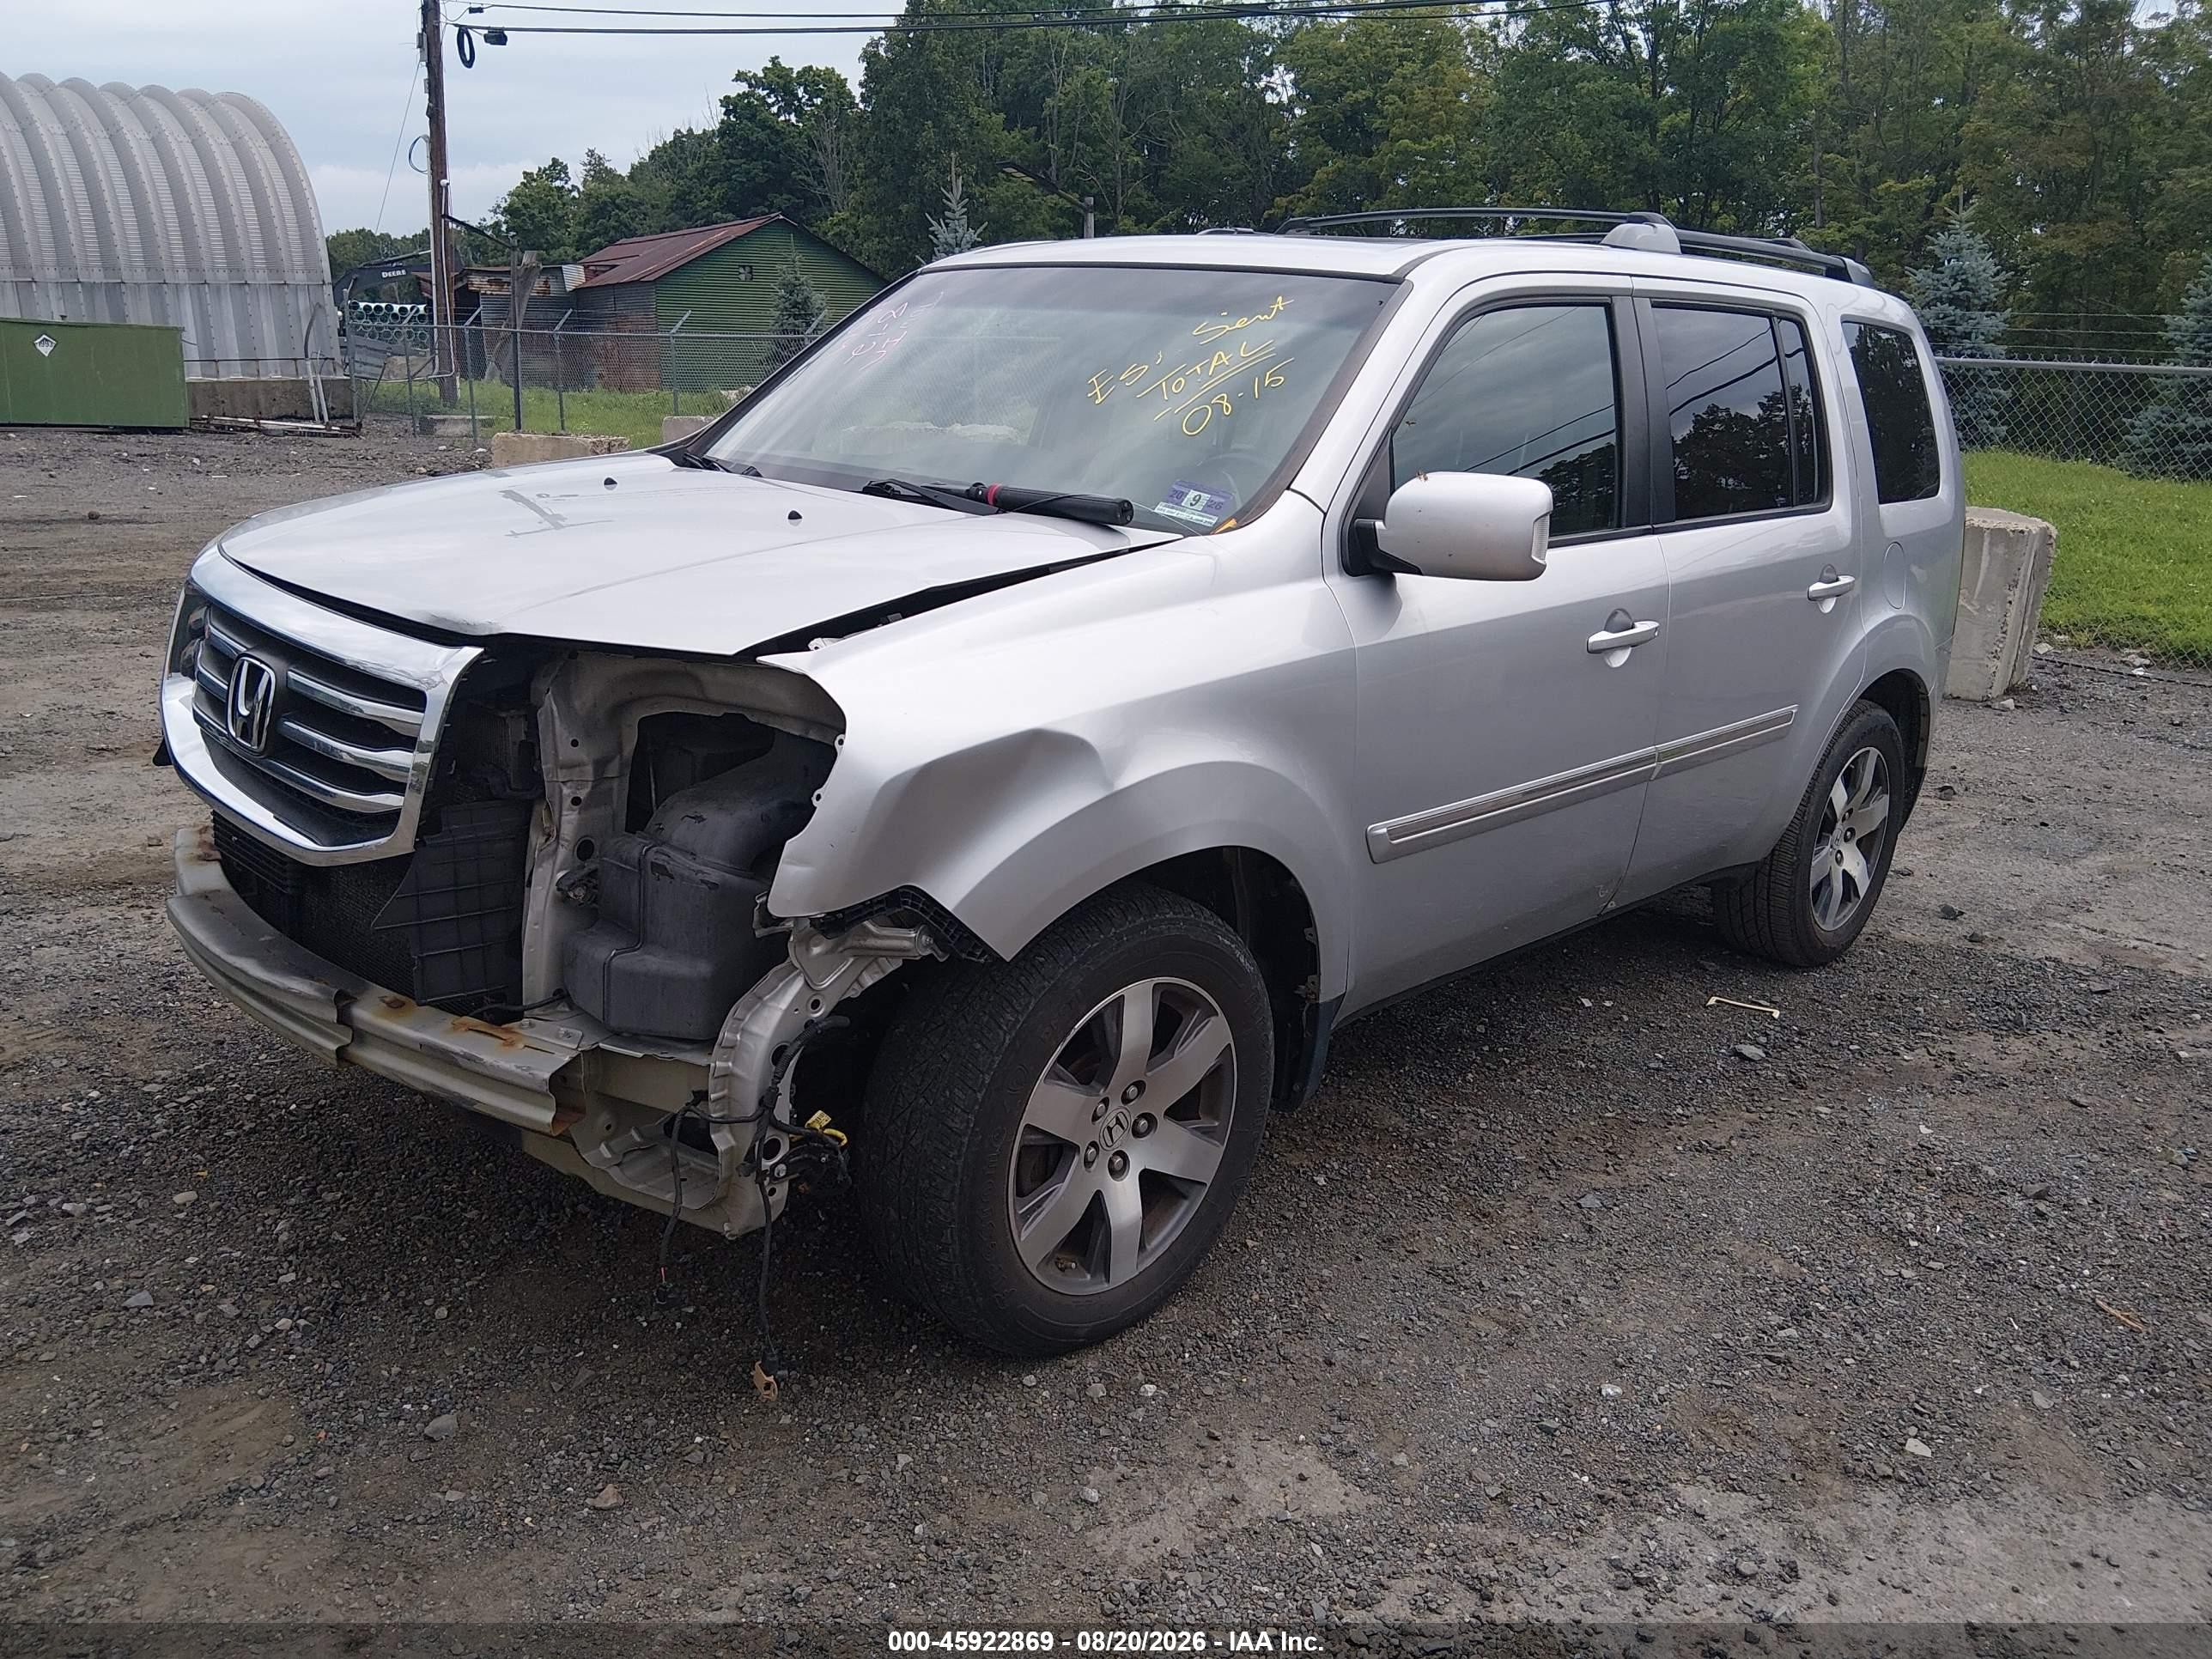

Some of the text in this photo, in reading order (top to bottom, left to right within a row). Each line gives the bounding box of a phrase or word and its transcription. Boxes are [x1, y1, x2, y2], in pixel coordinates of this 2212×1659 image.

[381, 269, 407, 278] DEERE
[1136, 339, 1274, 401] TOTAL
[1189, 494, 1202, 507] 9
